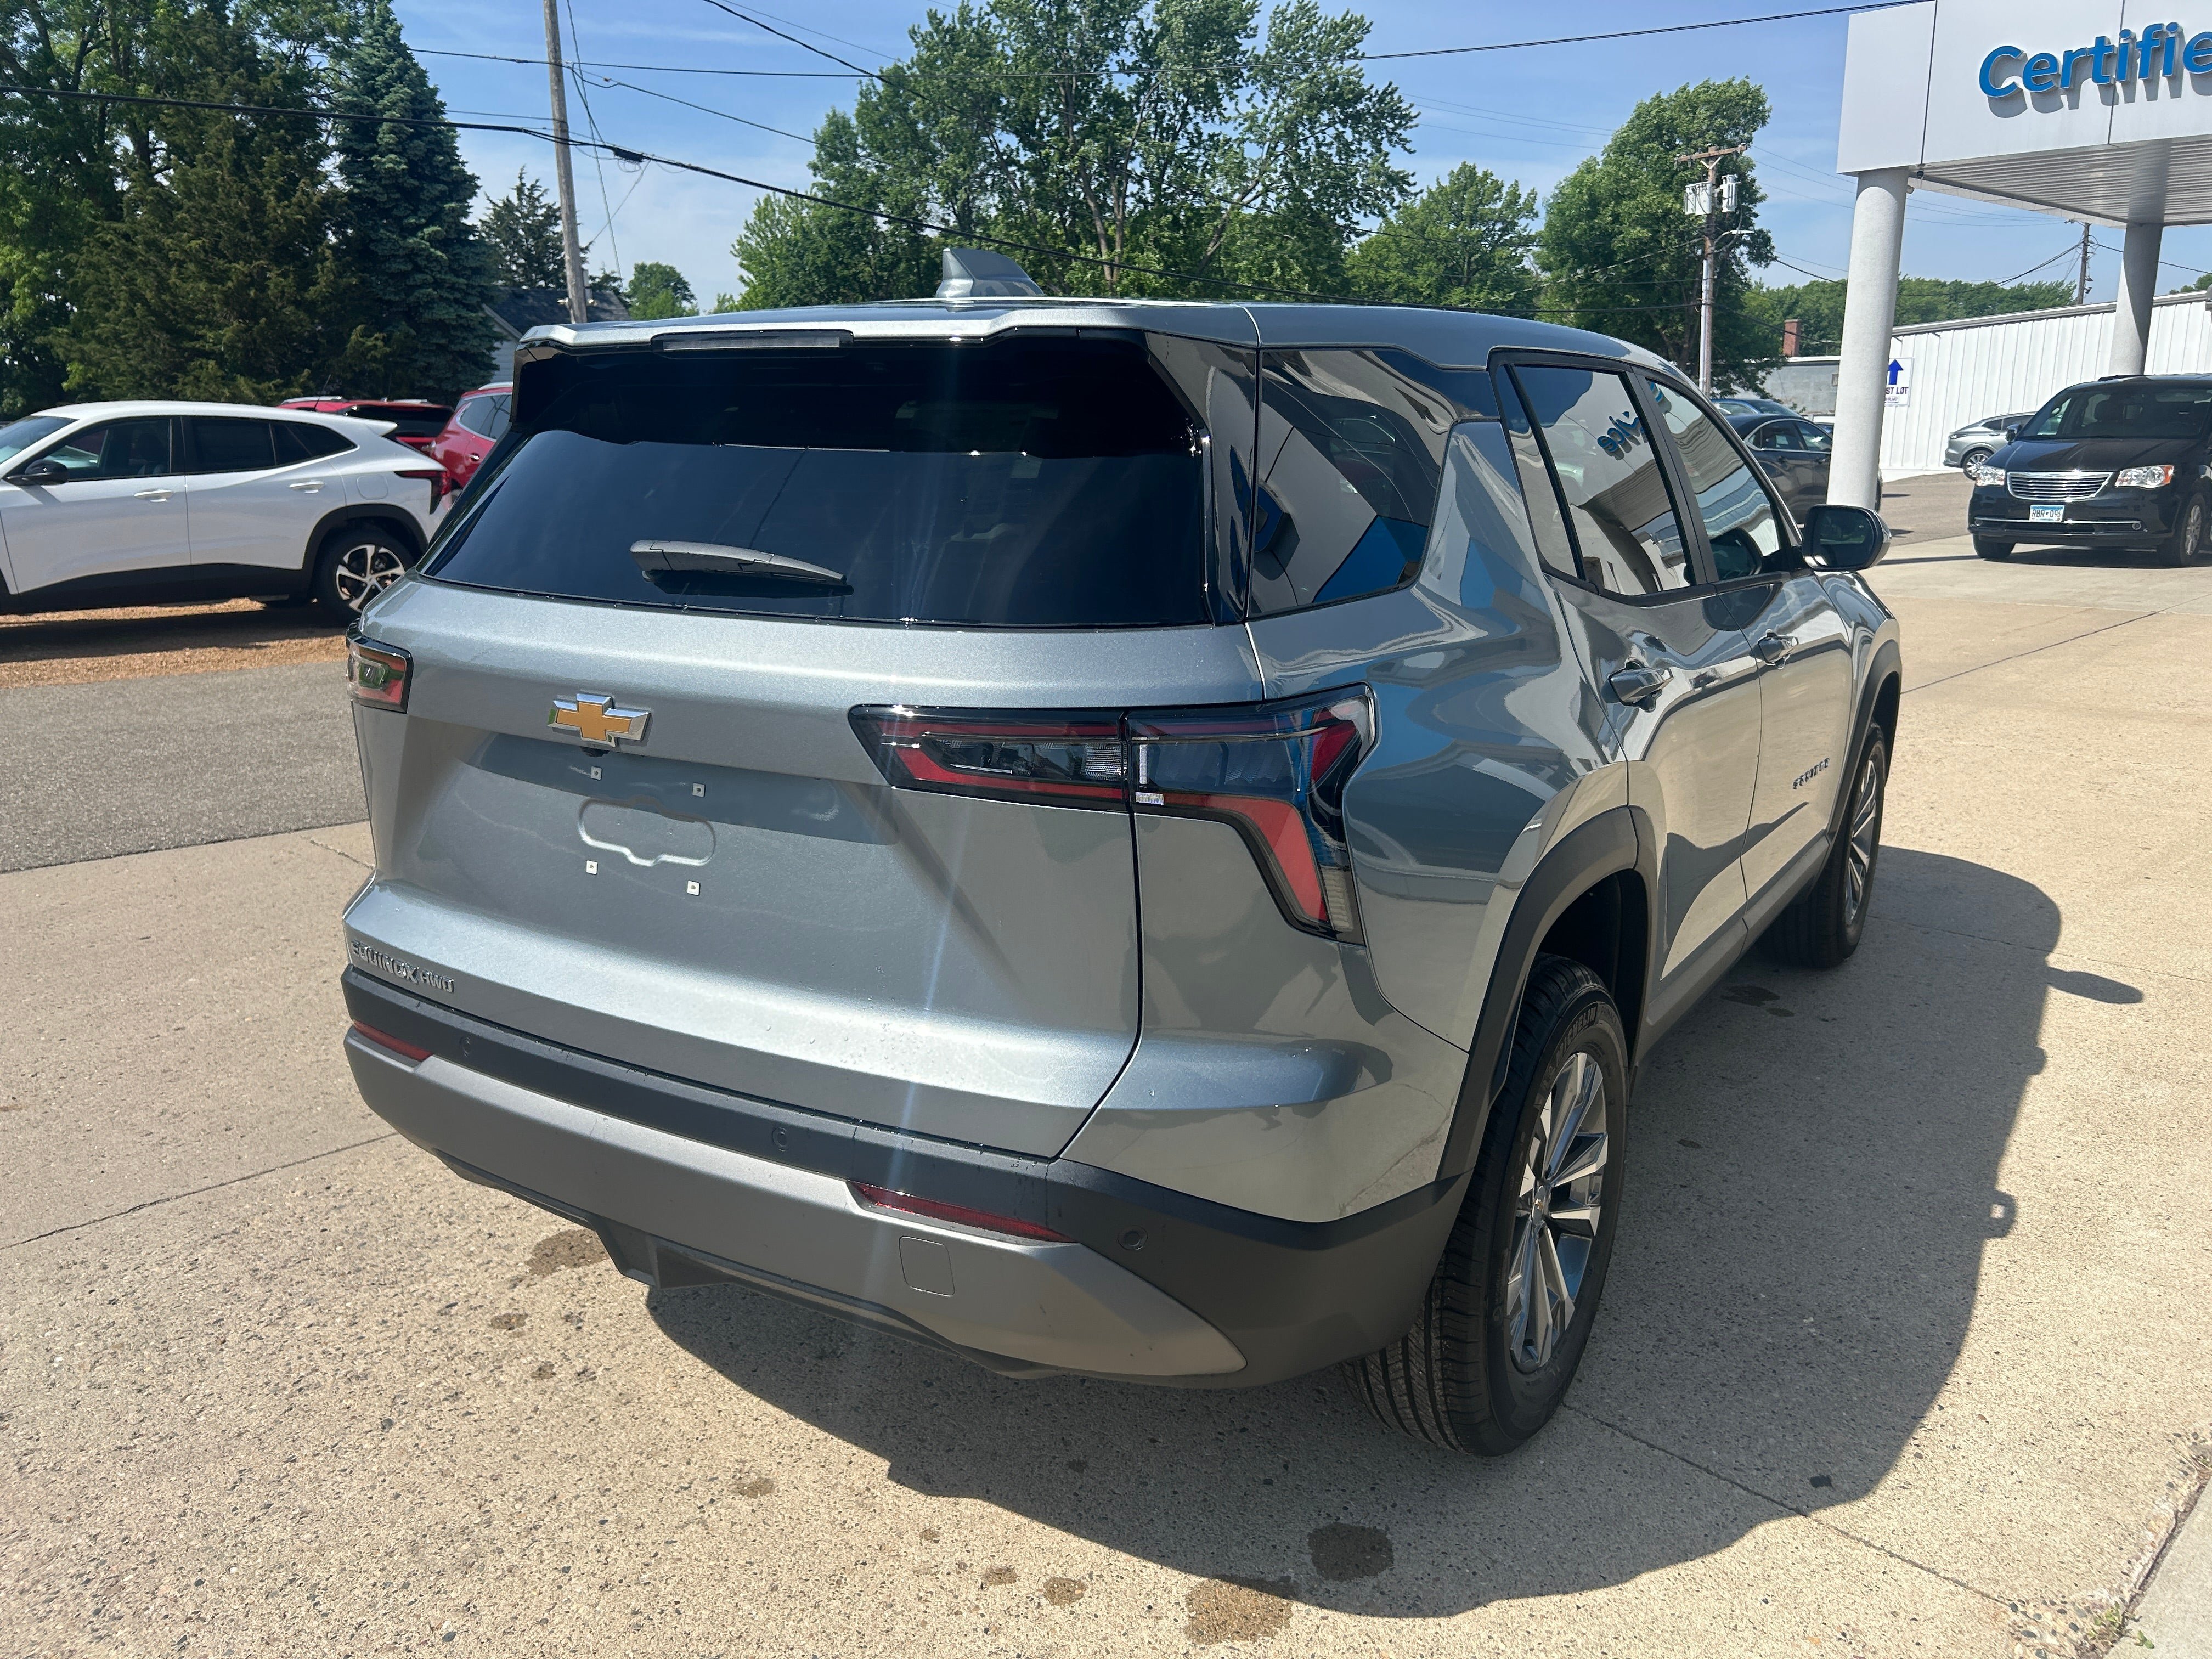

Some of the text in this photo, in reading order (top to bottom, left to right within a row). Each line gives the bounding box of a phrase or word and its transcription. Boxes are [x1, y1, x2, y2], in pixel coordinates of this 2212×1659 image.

[351, 939, 455, 994] EQUINOX AWD
[1556, 1006, 1598, 1068] MICHELIN
